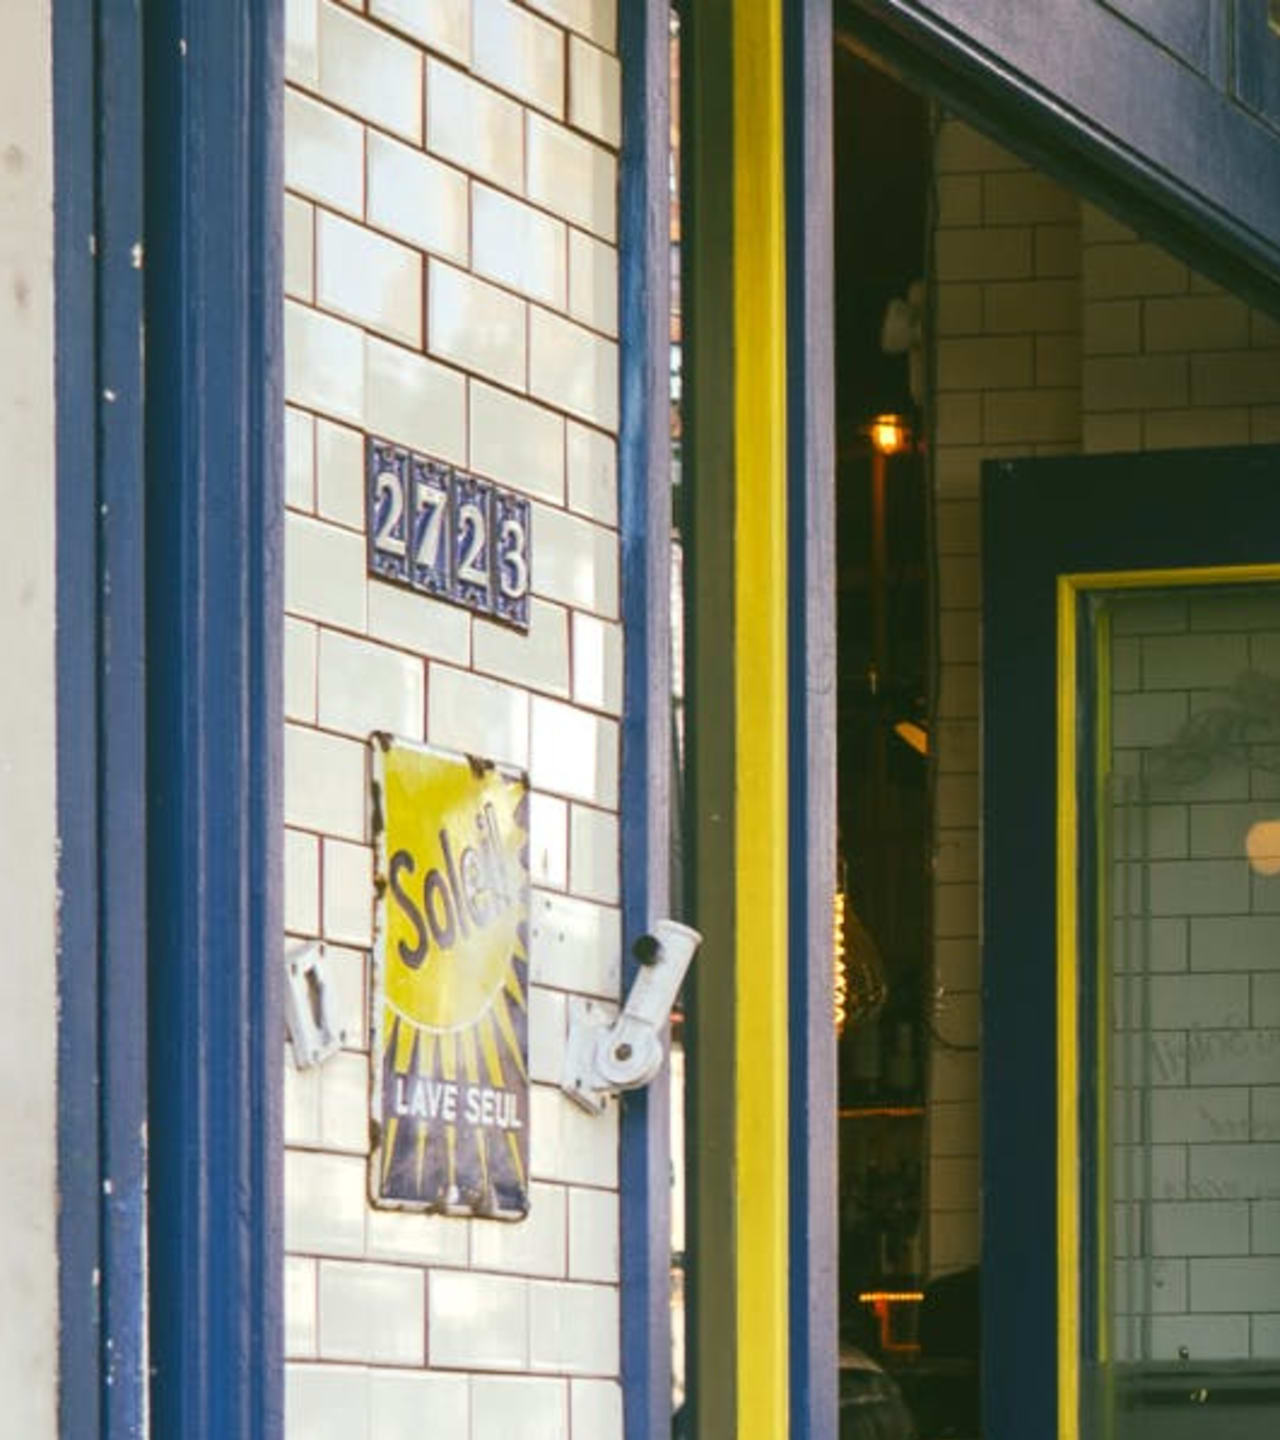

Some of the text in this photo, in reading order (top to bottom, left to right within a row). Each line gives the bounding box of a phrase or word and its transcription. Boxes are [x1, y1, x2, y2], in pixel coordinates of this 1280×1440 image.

[375, 472, 528, 599] 2723
[388, 801, 511, 970] Soleil
[395, 1077, 524, 1130] LAVE SEUL
